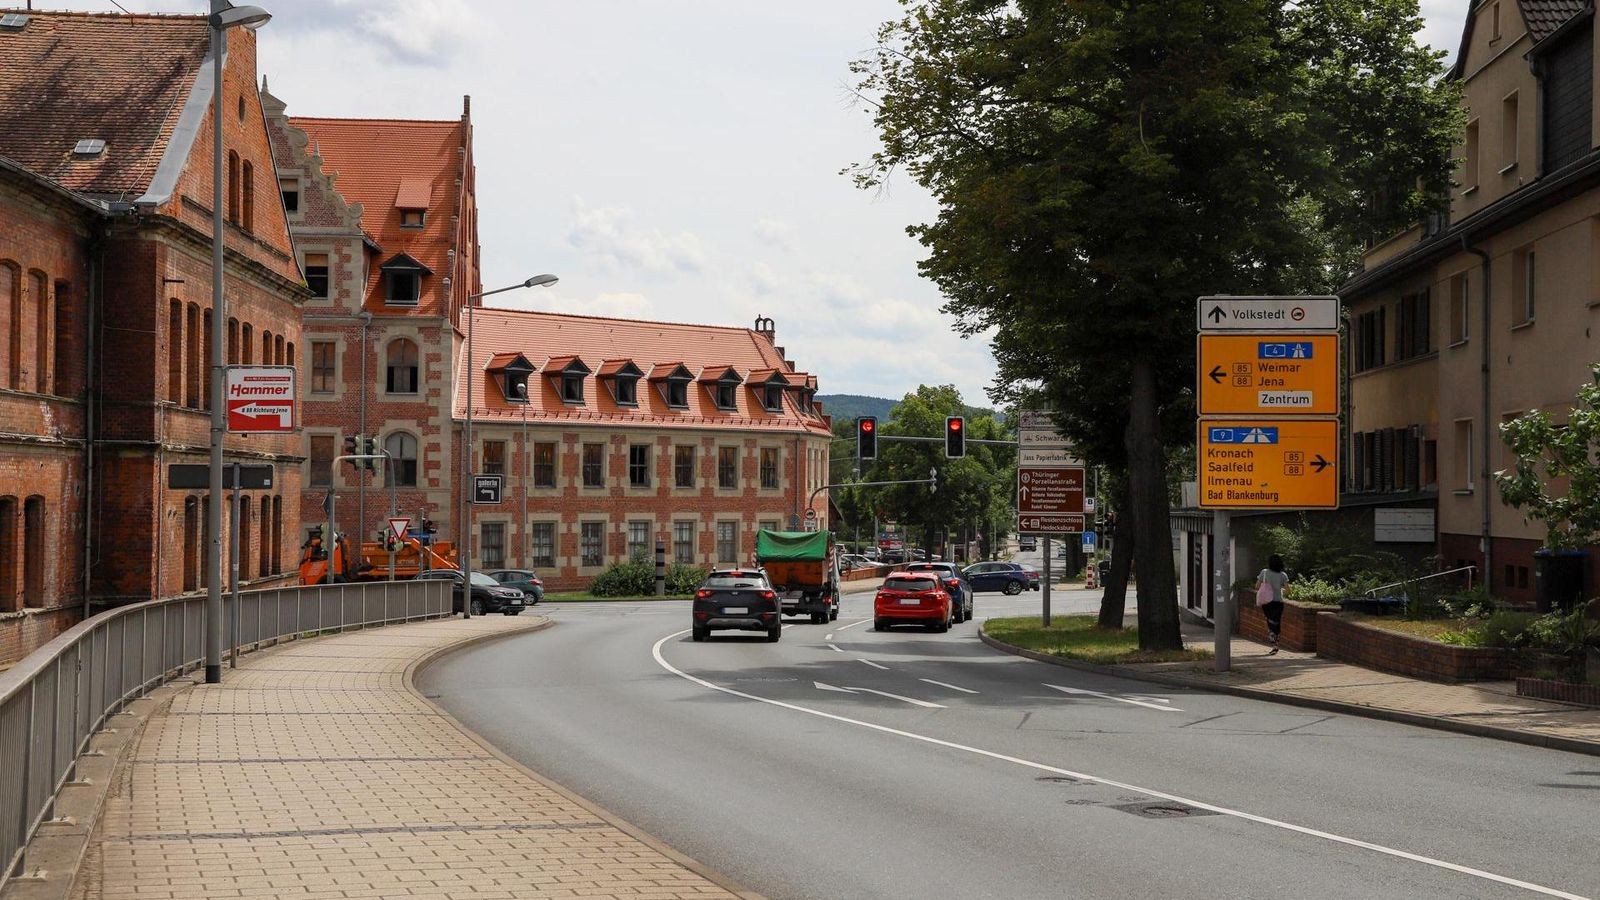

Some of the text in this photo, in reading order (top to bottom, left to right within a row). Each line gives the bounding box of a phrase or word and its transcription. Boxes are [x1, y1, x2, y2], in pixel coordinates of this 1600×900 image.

[1232, 309, 1285, 320] Volkstedt
[1273, 347, 1278, 355] 4
[1258, 363, 1301, 373] Weimar
[1237, 377, 1247, 385] 88
[1258, 377, 1284, 386] Jena
[230, 384, 289, 397] Hammer
[1262, 394, 1309, 404] Zentrum
[1221, 432, 1225, 440] 9
[1036, 454, 1067, 462] Papierfabrik
[1208, 449, 1253, 458] Kronach
[1208, 462, 1253, 472] Saalfeld
[1288, 466, 1299, 474] 88
[1208, 476, 1252, 486] Ilmenau
[1208, 490, 1279, 502] Bad Blankenburg
